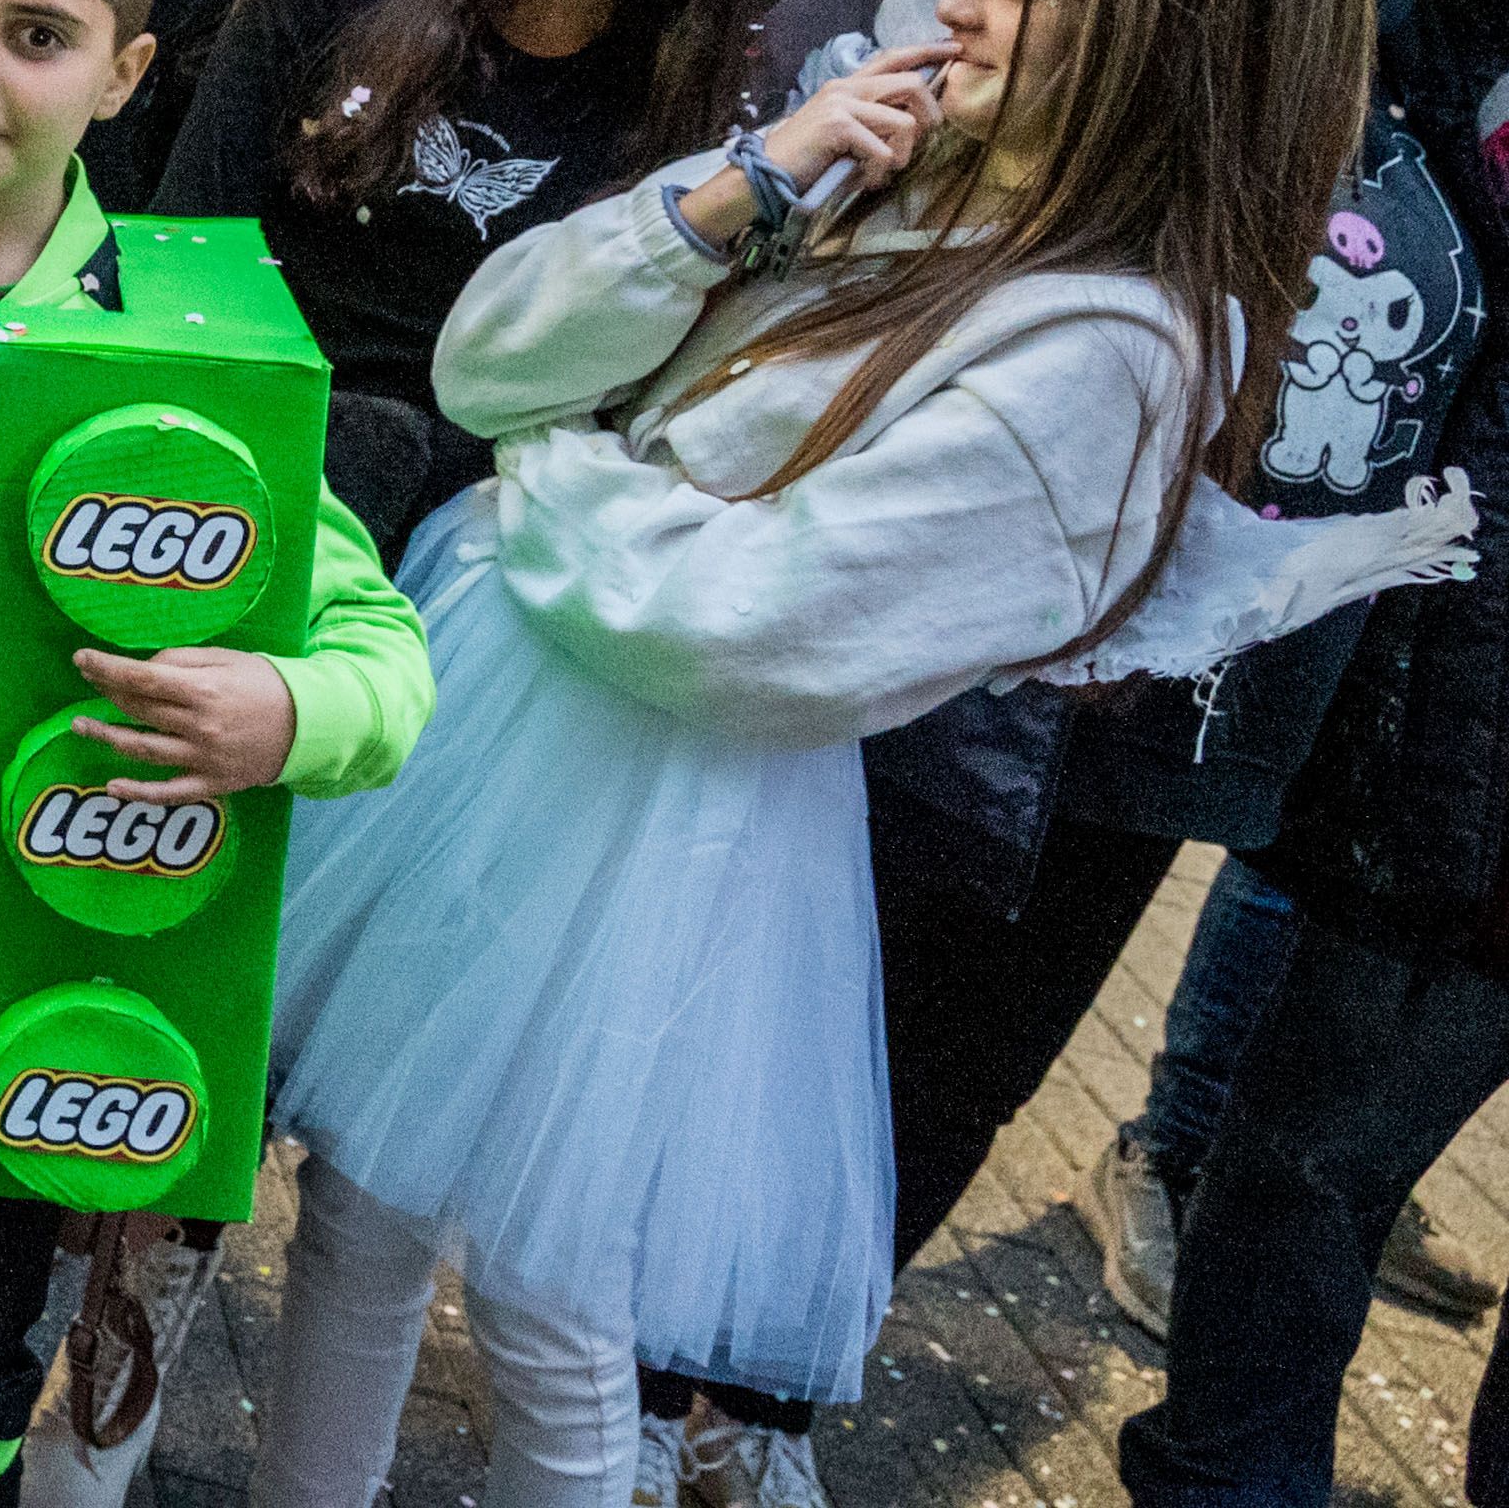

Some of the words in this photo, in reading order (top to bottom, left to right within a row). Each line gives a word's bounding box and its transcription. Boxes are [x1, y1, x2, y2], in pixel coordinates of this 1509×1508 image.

[52, 500, 247, 583] LEGO
[27, 790, 216, 868] LEGO
[2, 1075, 188, 1155] LEGO
